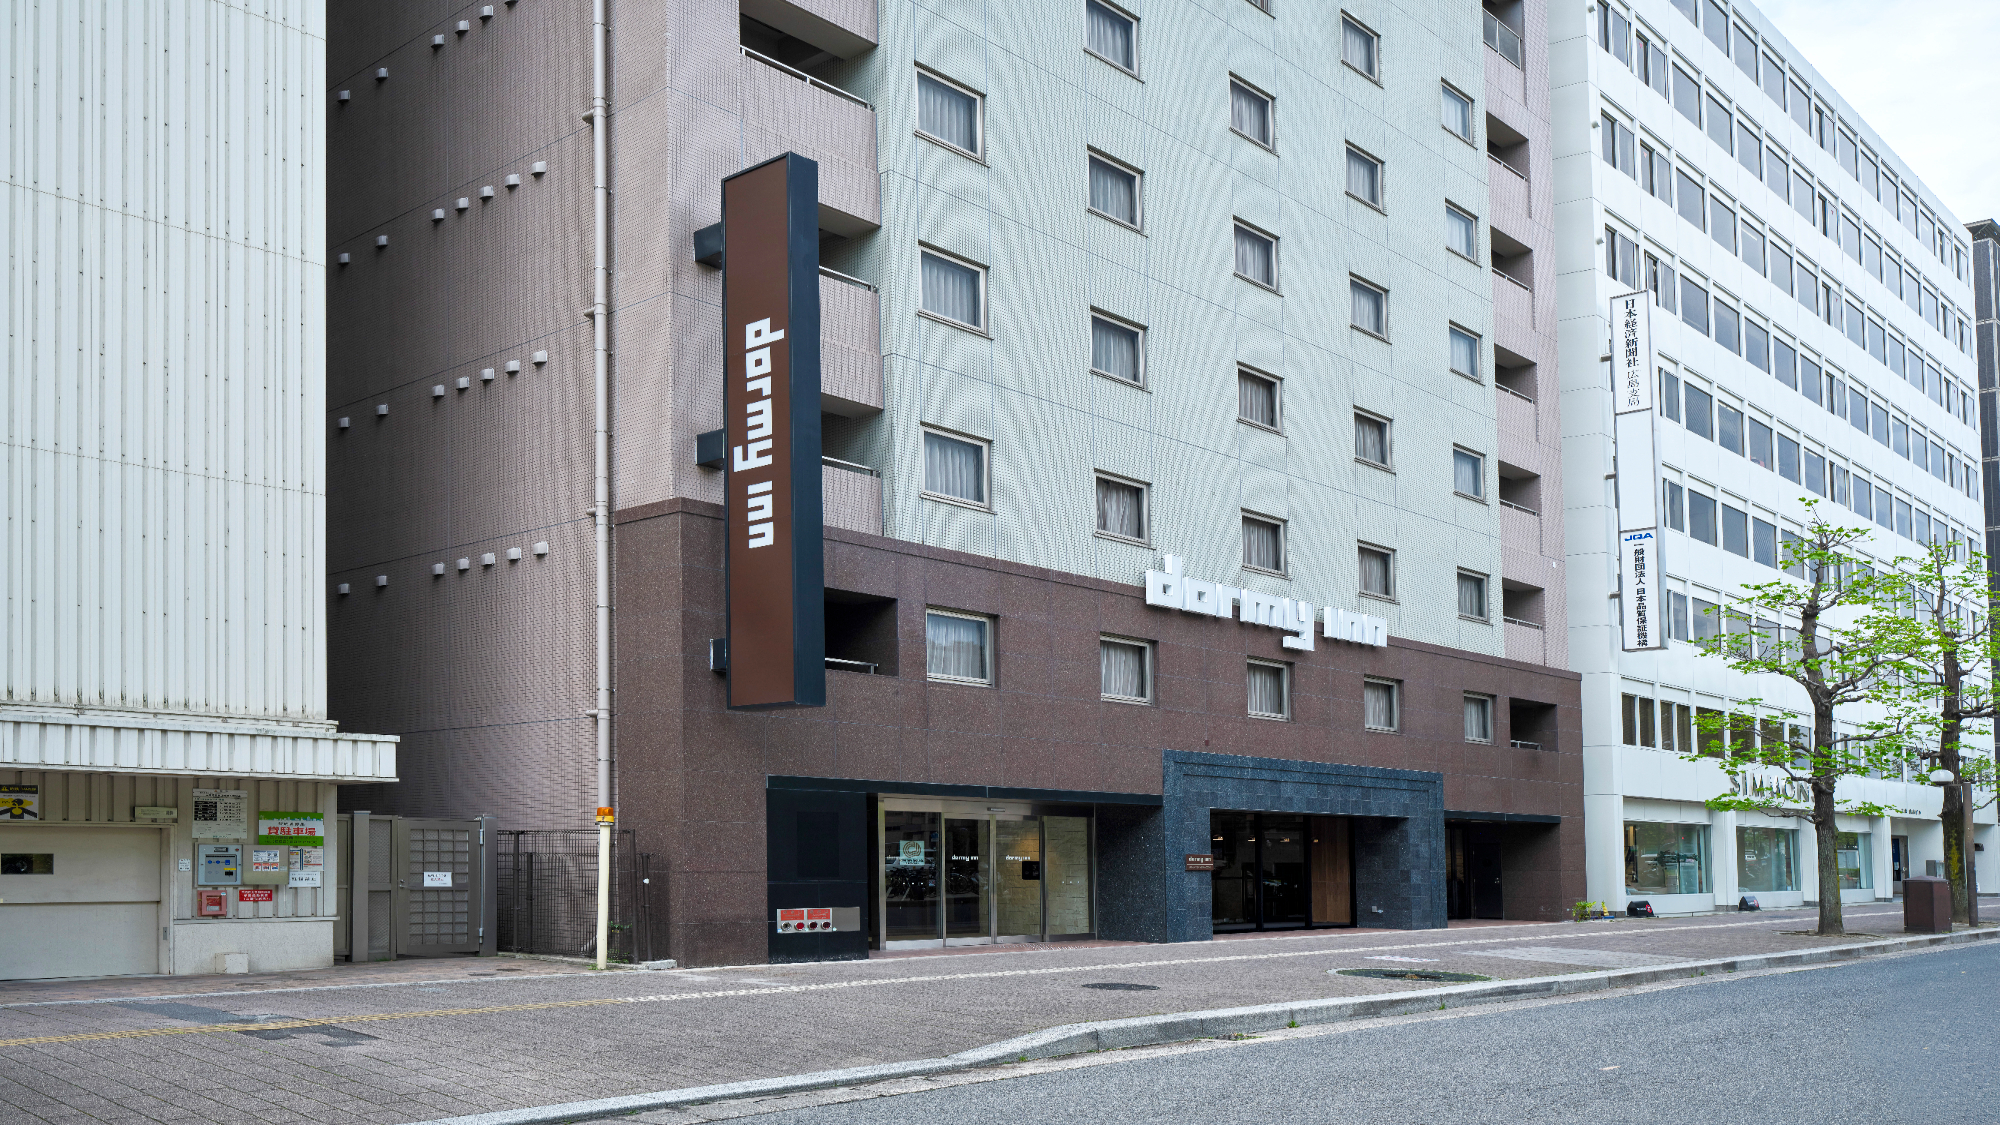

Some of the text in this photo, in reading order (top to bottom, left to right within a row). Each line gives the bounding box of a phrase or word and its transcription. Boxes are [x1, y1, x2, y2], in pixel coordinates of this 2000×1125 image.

[1625, 299, 1639, 368] 日本経済新聞社
[733, 317, 785, 549] dormy inn
[1624, 532, 1654, 541] JQA
[1634, 543, 1645, 585] 一般財団法人
[1146, 554, 1388, 651] dormy inn
[1730, 771, 1815, 803] SIMMON
[267, 825, 317, 836] 貸駐車場
